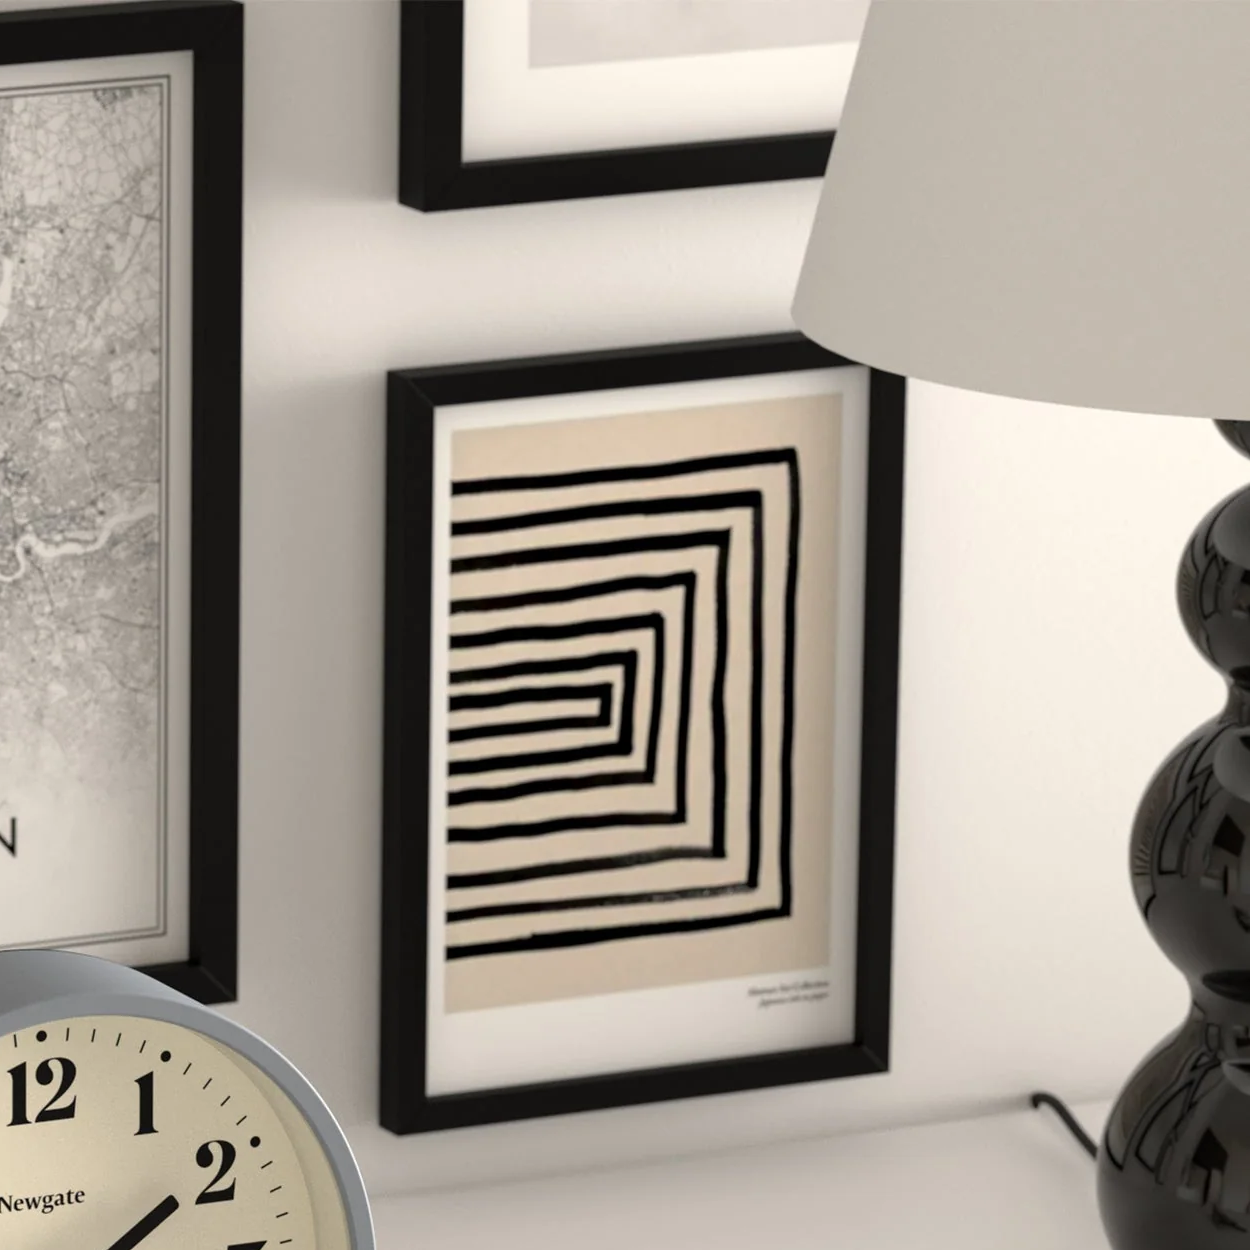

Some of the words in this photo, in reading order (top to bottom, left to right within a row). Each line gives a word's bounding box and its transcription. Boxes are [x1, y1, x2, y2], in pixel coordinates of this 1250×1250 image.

[7, 1057, 77, 1127] 12
[134, 1071, 159, 1136] 1
[194, 1139, 237, 1206] 2
